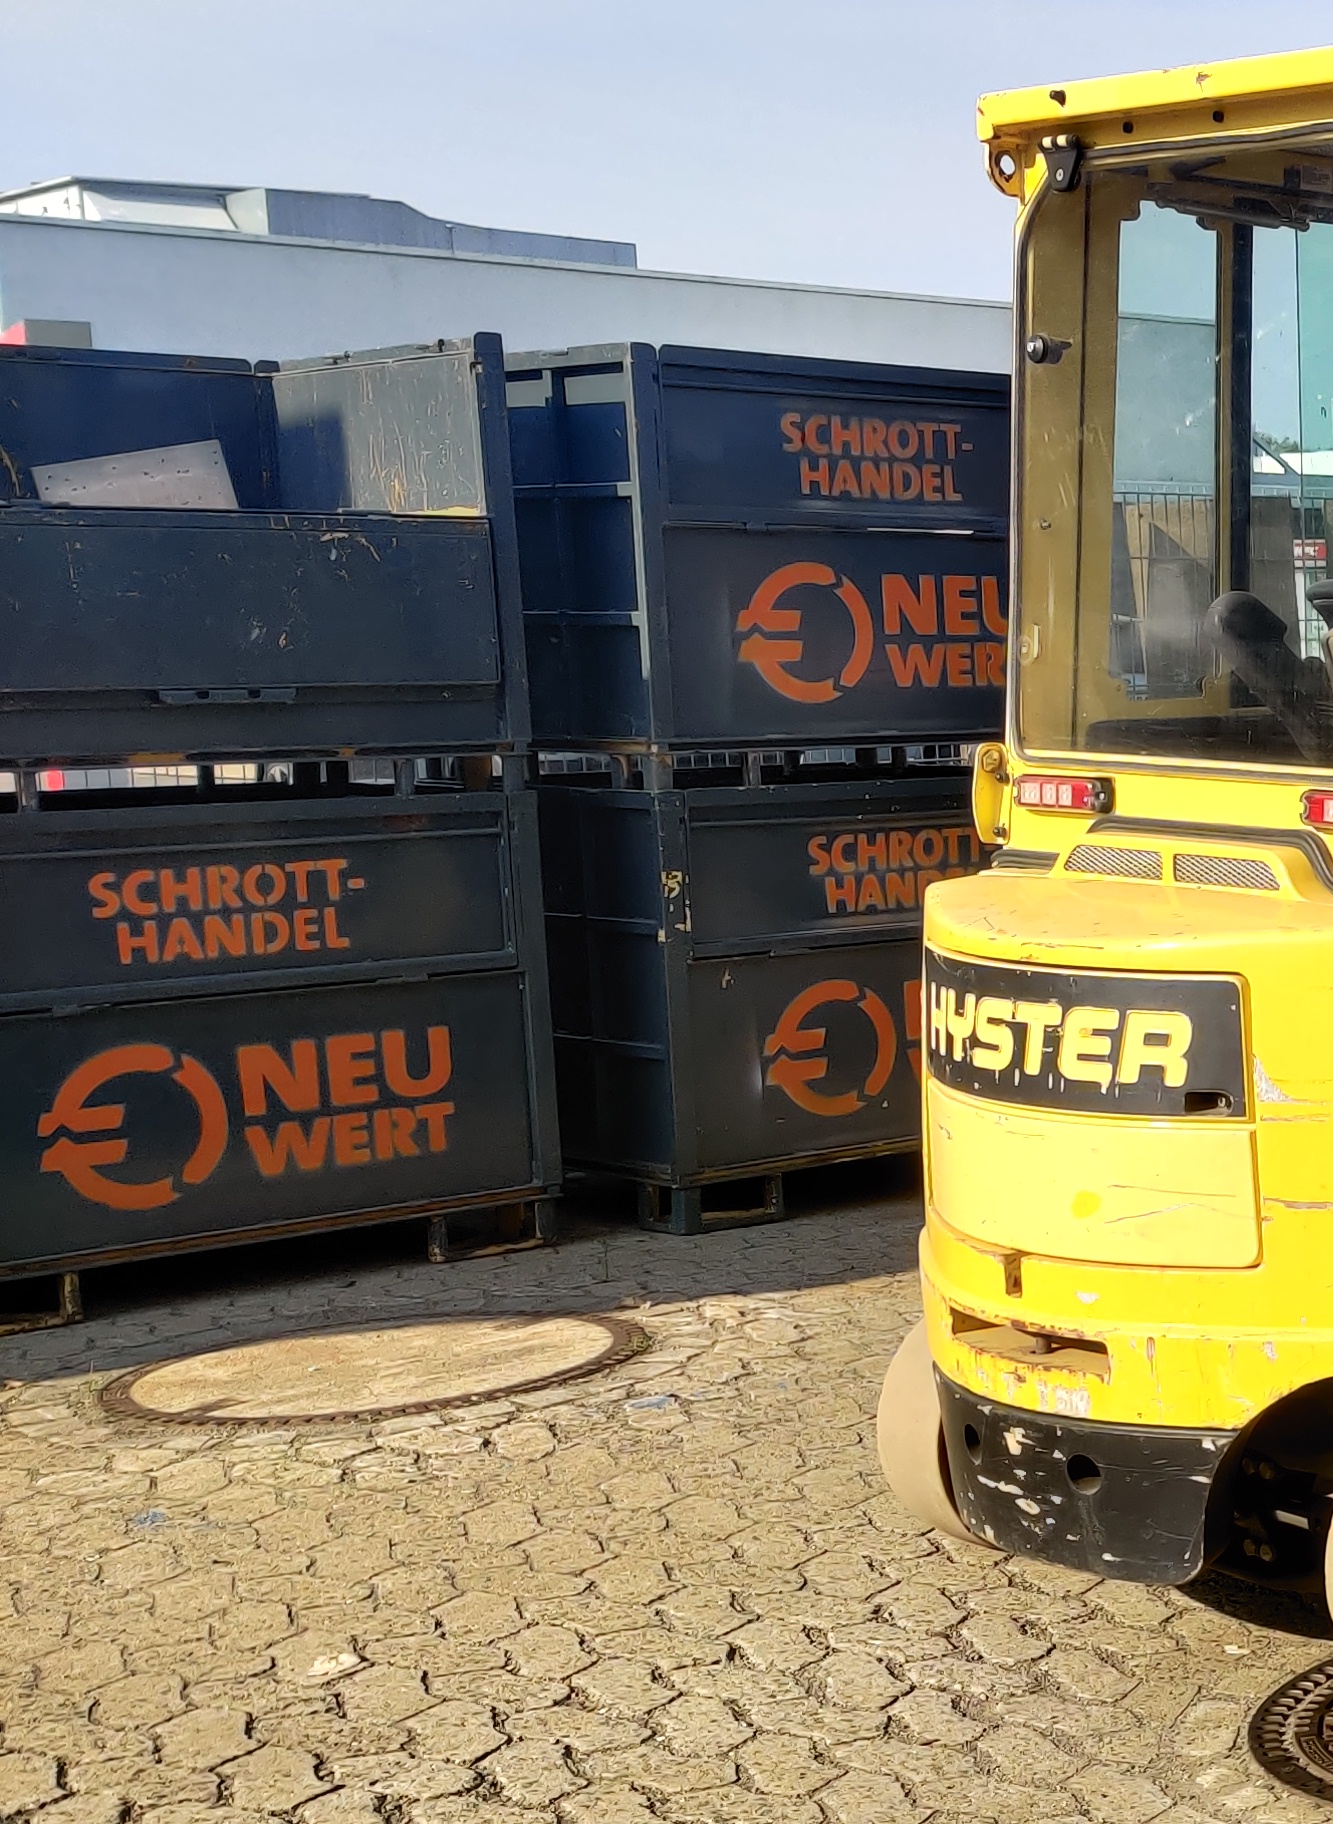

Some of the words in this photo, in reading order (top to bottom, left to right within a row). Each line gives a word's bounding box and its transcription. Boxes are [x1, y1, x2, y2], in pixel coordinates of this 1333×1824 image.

[780, 412, 974, 460] SCHROTT-
[801, 457, 963, 501] HANDEL
[884, 642, 1006, 688] WER
[88, 858, 365, 919] SCHROTT-
[117, 906, 351, 965] HANDEL
[930, 980, 1194, 1089] HYSTER
[236, 1025, 454, 1117] NEU
[243, 1102, 455, 1178] WERT
